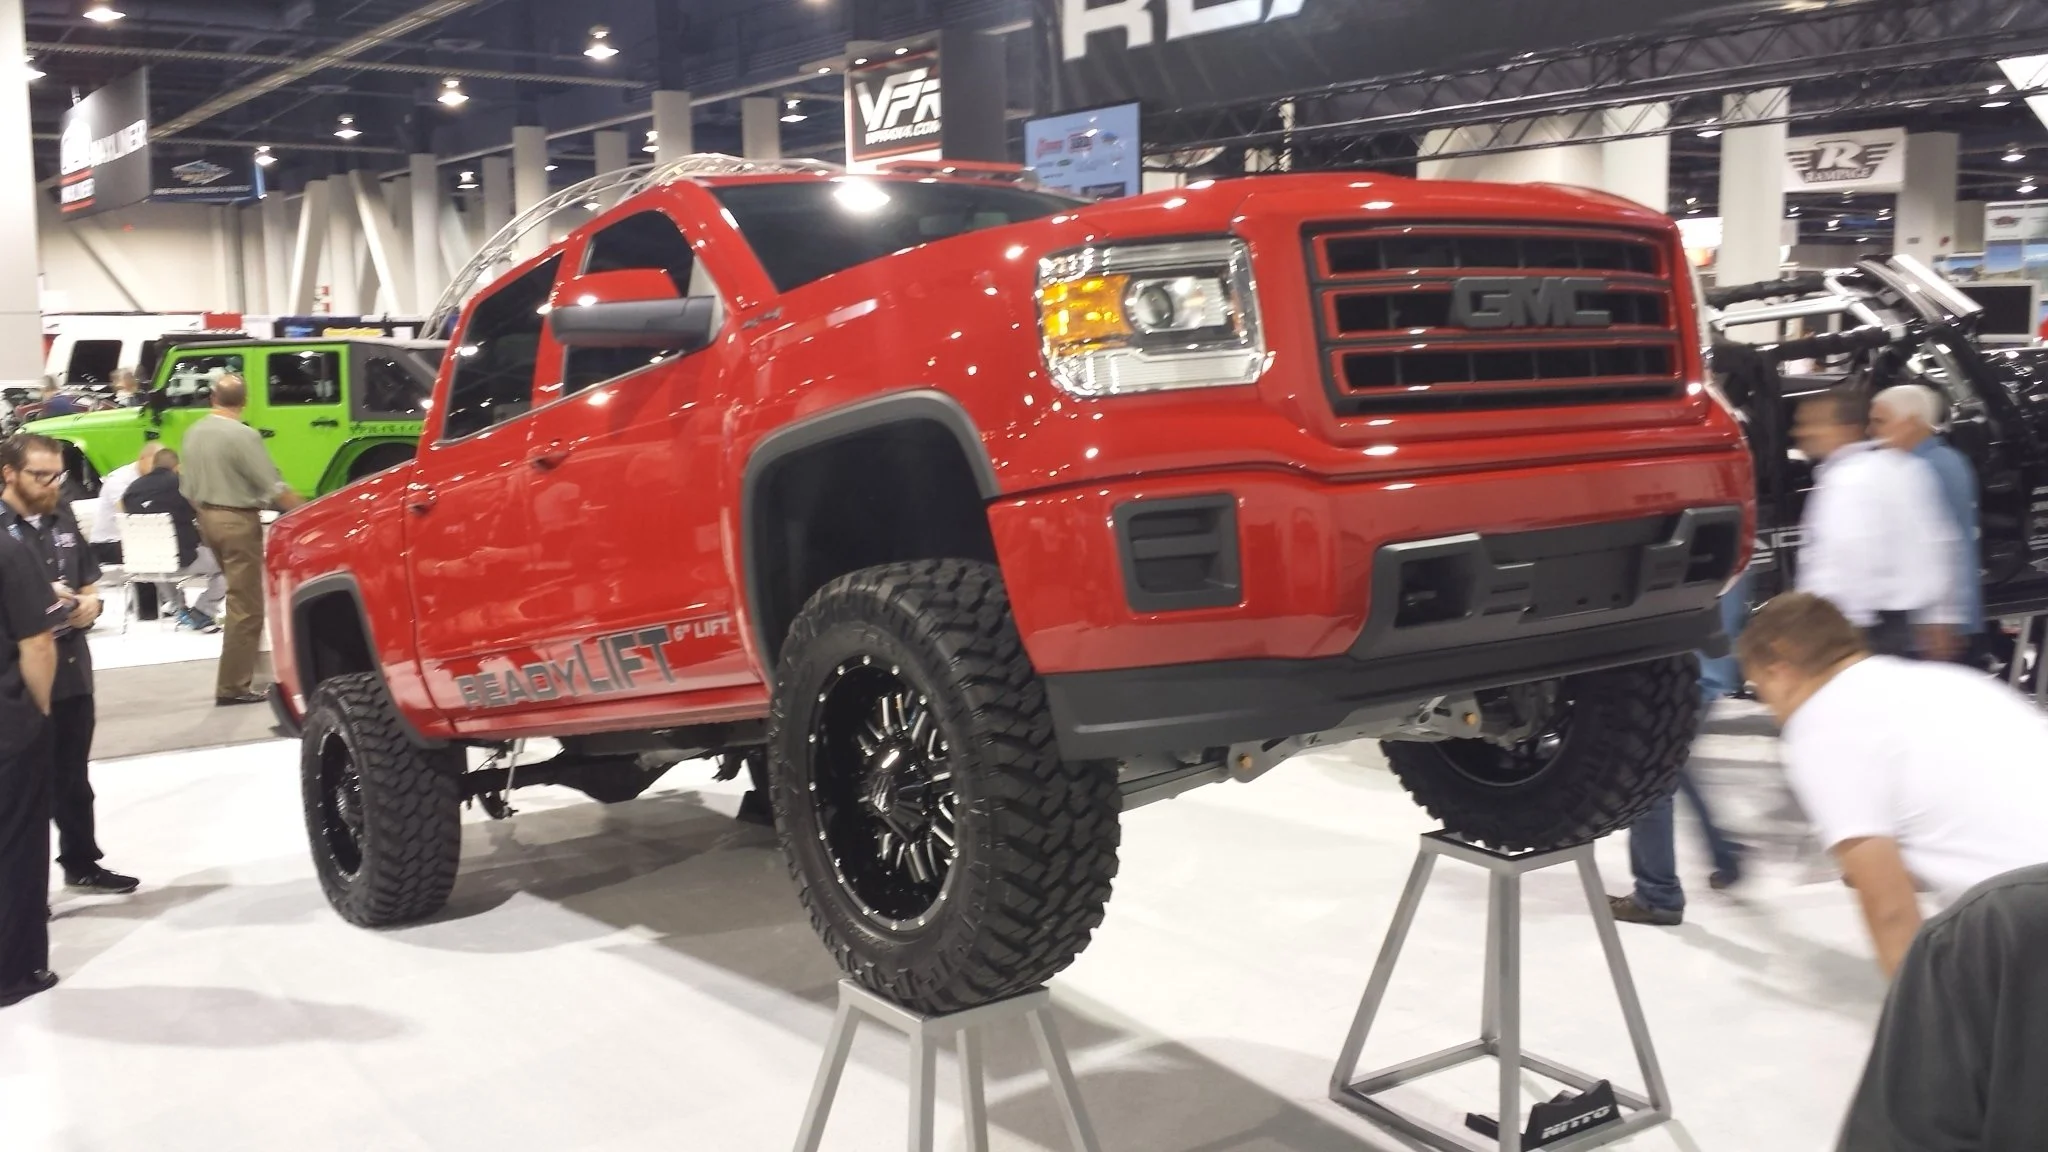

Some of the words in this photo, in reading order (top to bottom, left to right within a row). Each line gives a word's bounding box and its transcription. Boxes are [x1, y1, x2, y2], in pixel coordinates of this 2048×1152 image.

[1453, 276, 1610, 328] GMC
[455, 624, 677, 710] READYLIFT
[694, 616, 731, 638] LIFT
